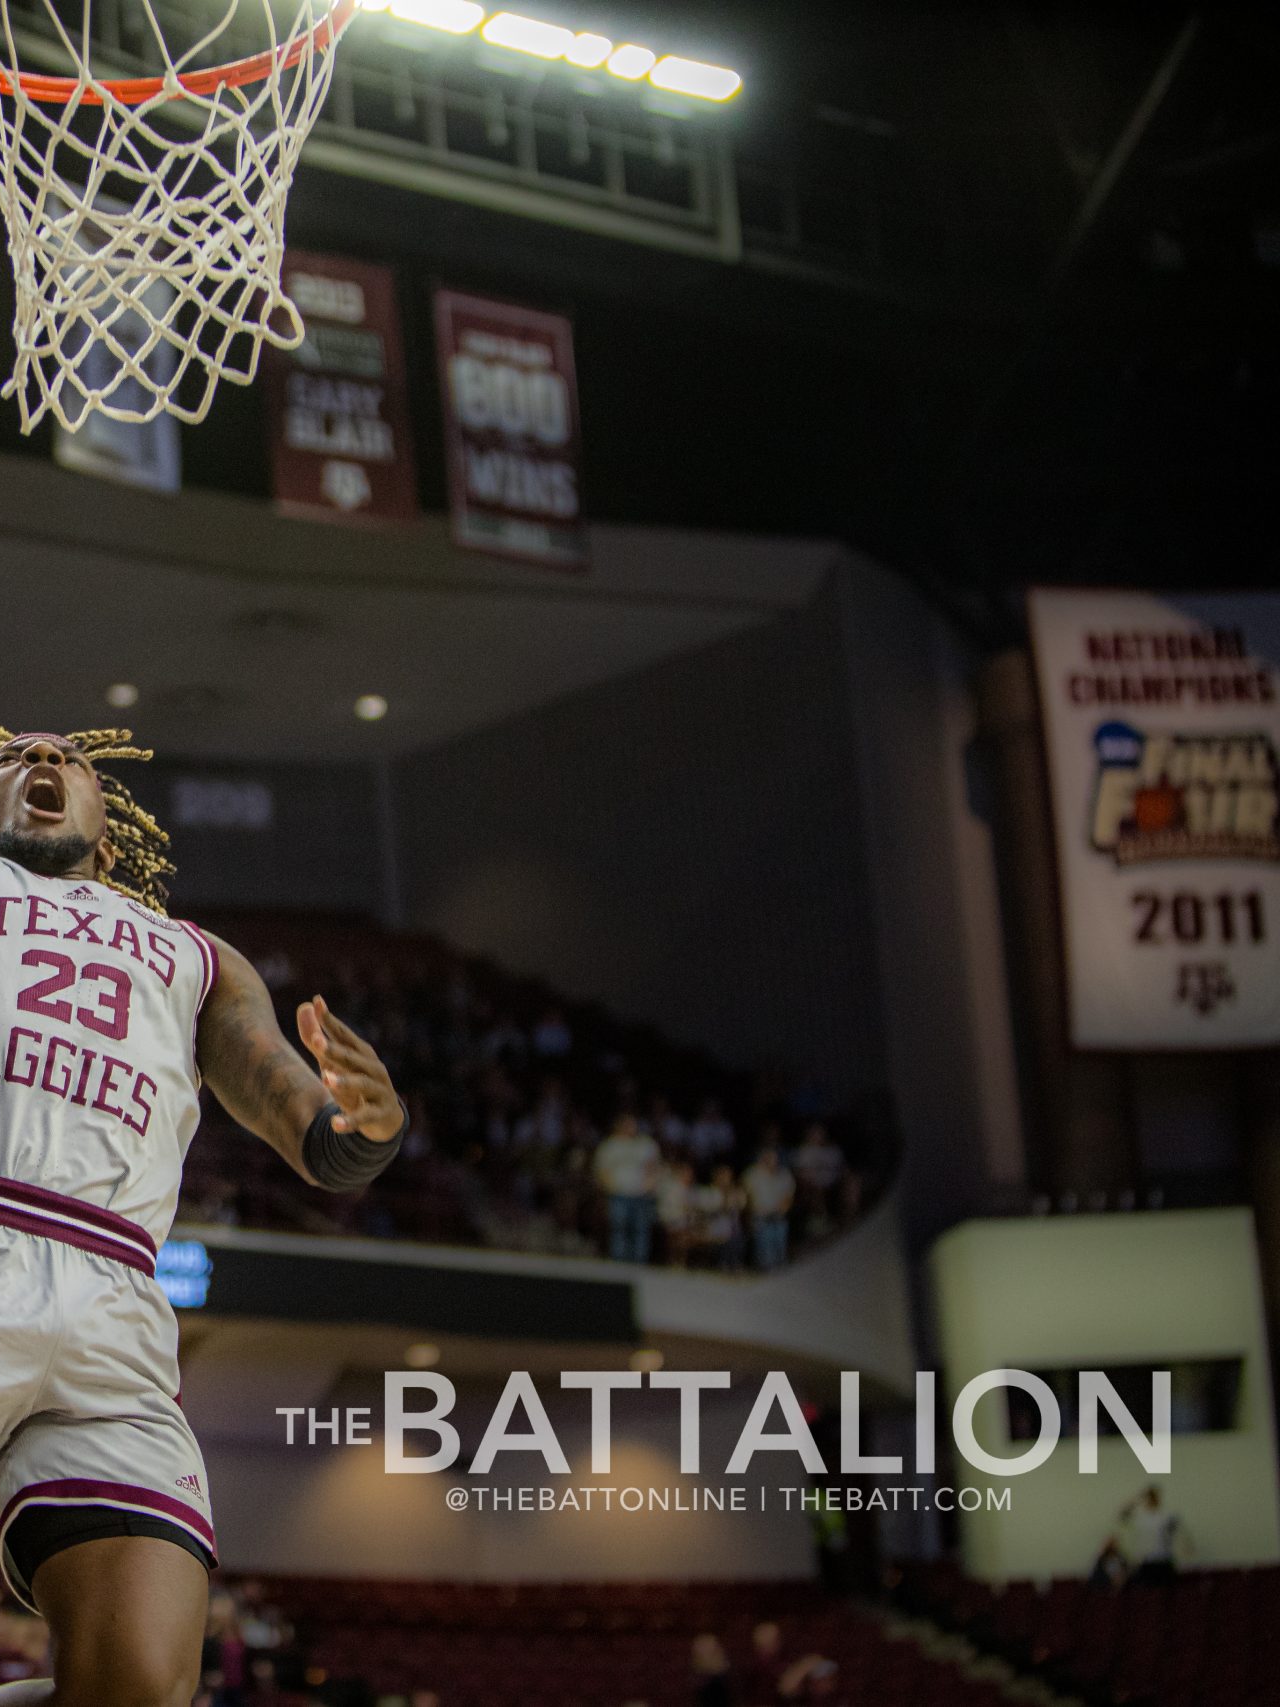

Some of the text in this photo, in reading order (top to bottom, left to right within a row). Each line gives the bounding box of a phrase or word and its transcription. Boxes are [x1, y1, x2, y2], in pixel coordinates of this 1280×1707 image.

[1085, 629, 1247, 662] NATIONAL
[1068, 671, 1276, 704] CHAMPIONS
[1132, 892, 1265, 944] 2011
[16, 949, 133, 1041] 23
